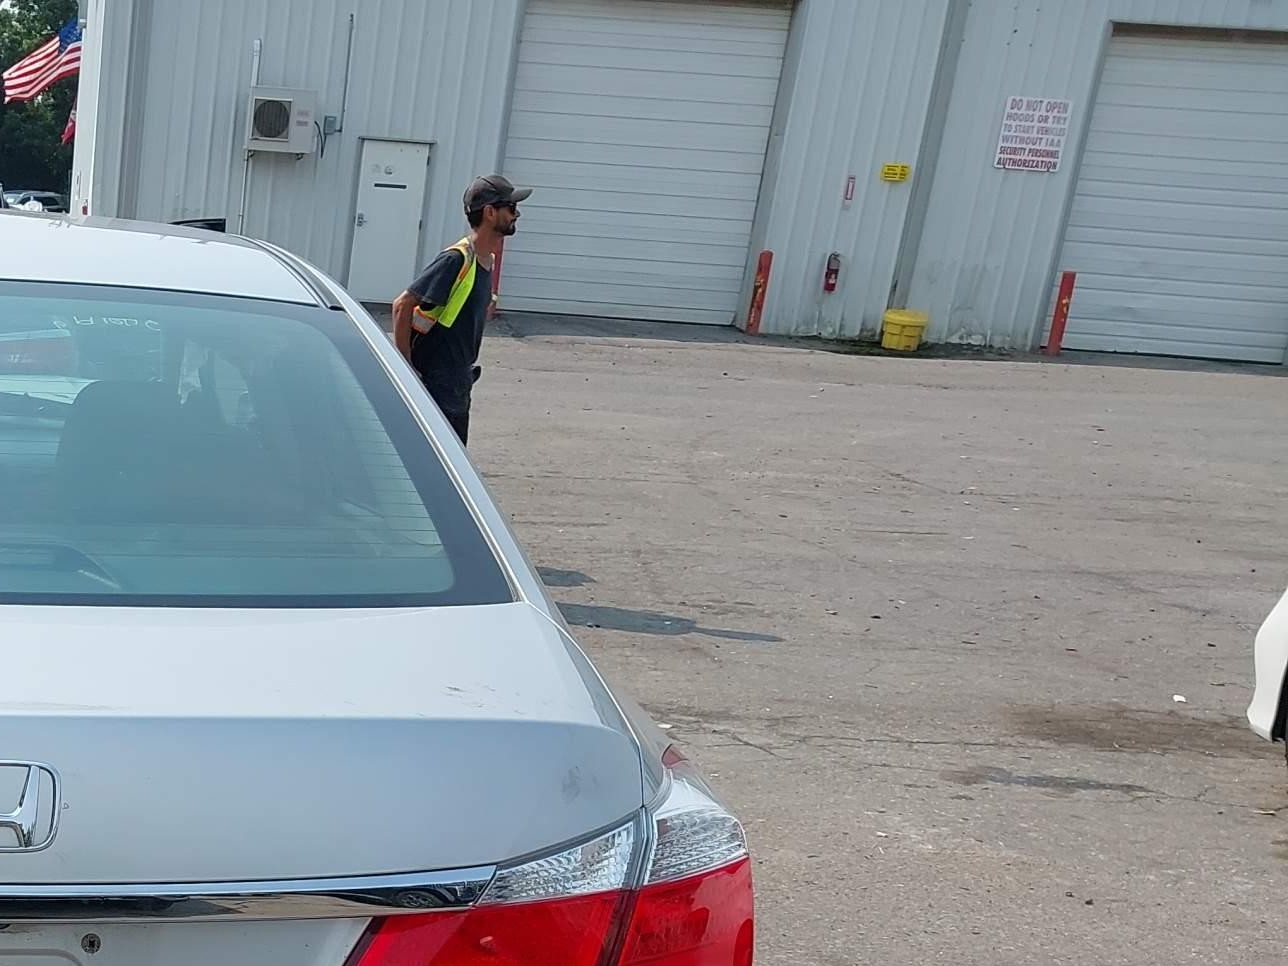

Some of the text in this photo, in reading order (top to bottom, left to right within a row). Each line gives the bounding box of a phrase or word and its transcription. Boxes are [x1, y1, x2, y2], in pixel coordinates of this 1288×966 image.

[1011, 98, 1069, 113] DO NOT OPEN
[1006, 112, 1067, 125] HOODS OR TRY
[1003, 123, 1066, 136] TO START VEHICLES
[1001, 135, 1044, 145] WITHOUT
[998, 145, 1060, 159] SECURITY PERSONNEL
[996, 157, 1058, 169] AUTHORIZATION
